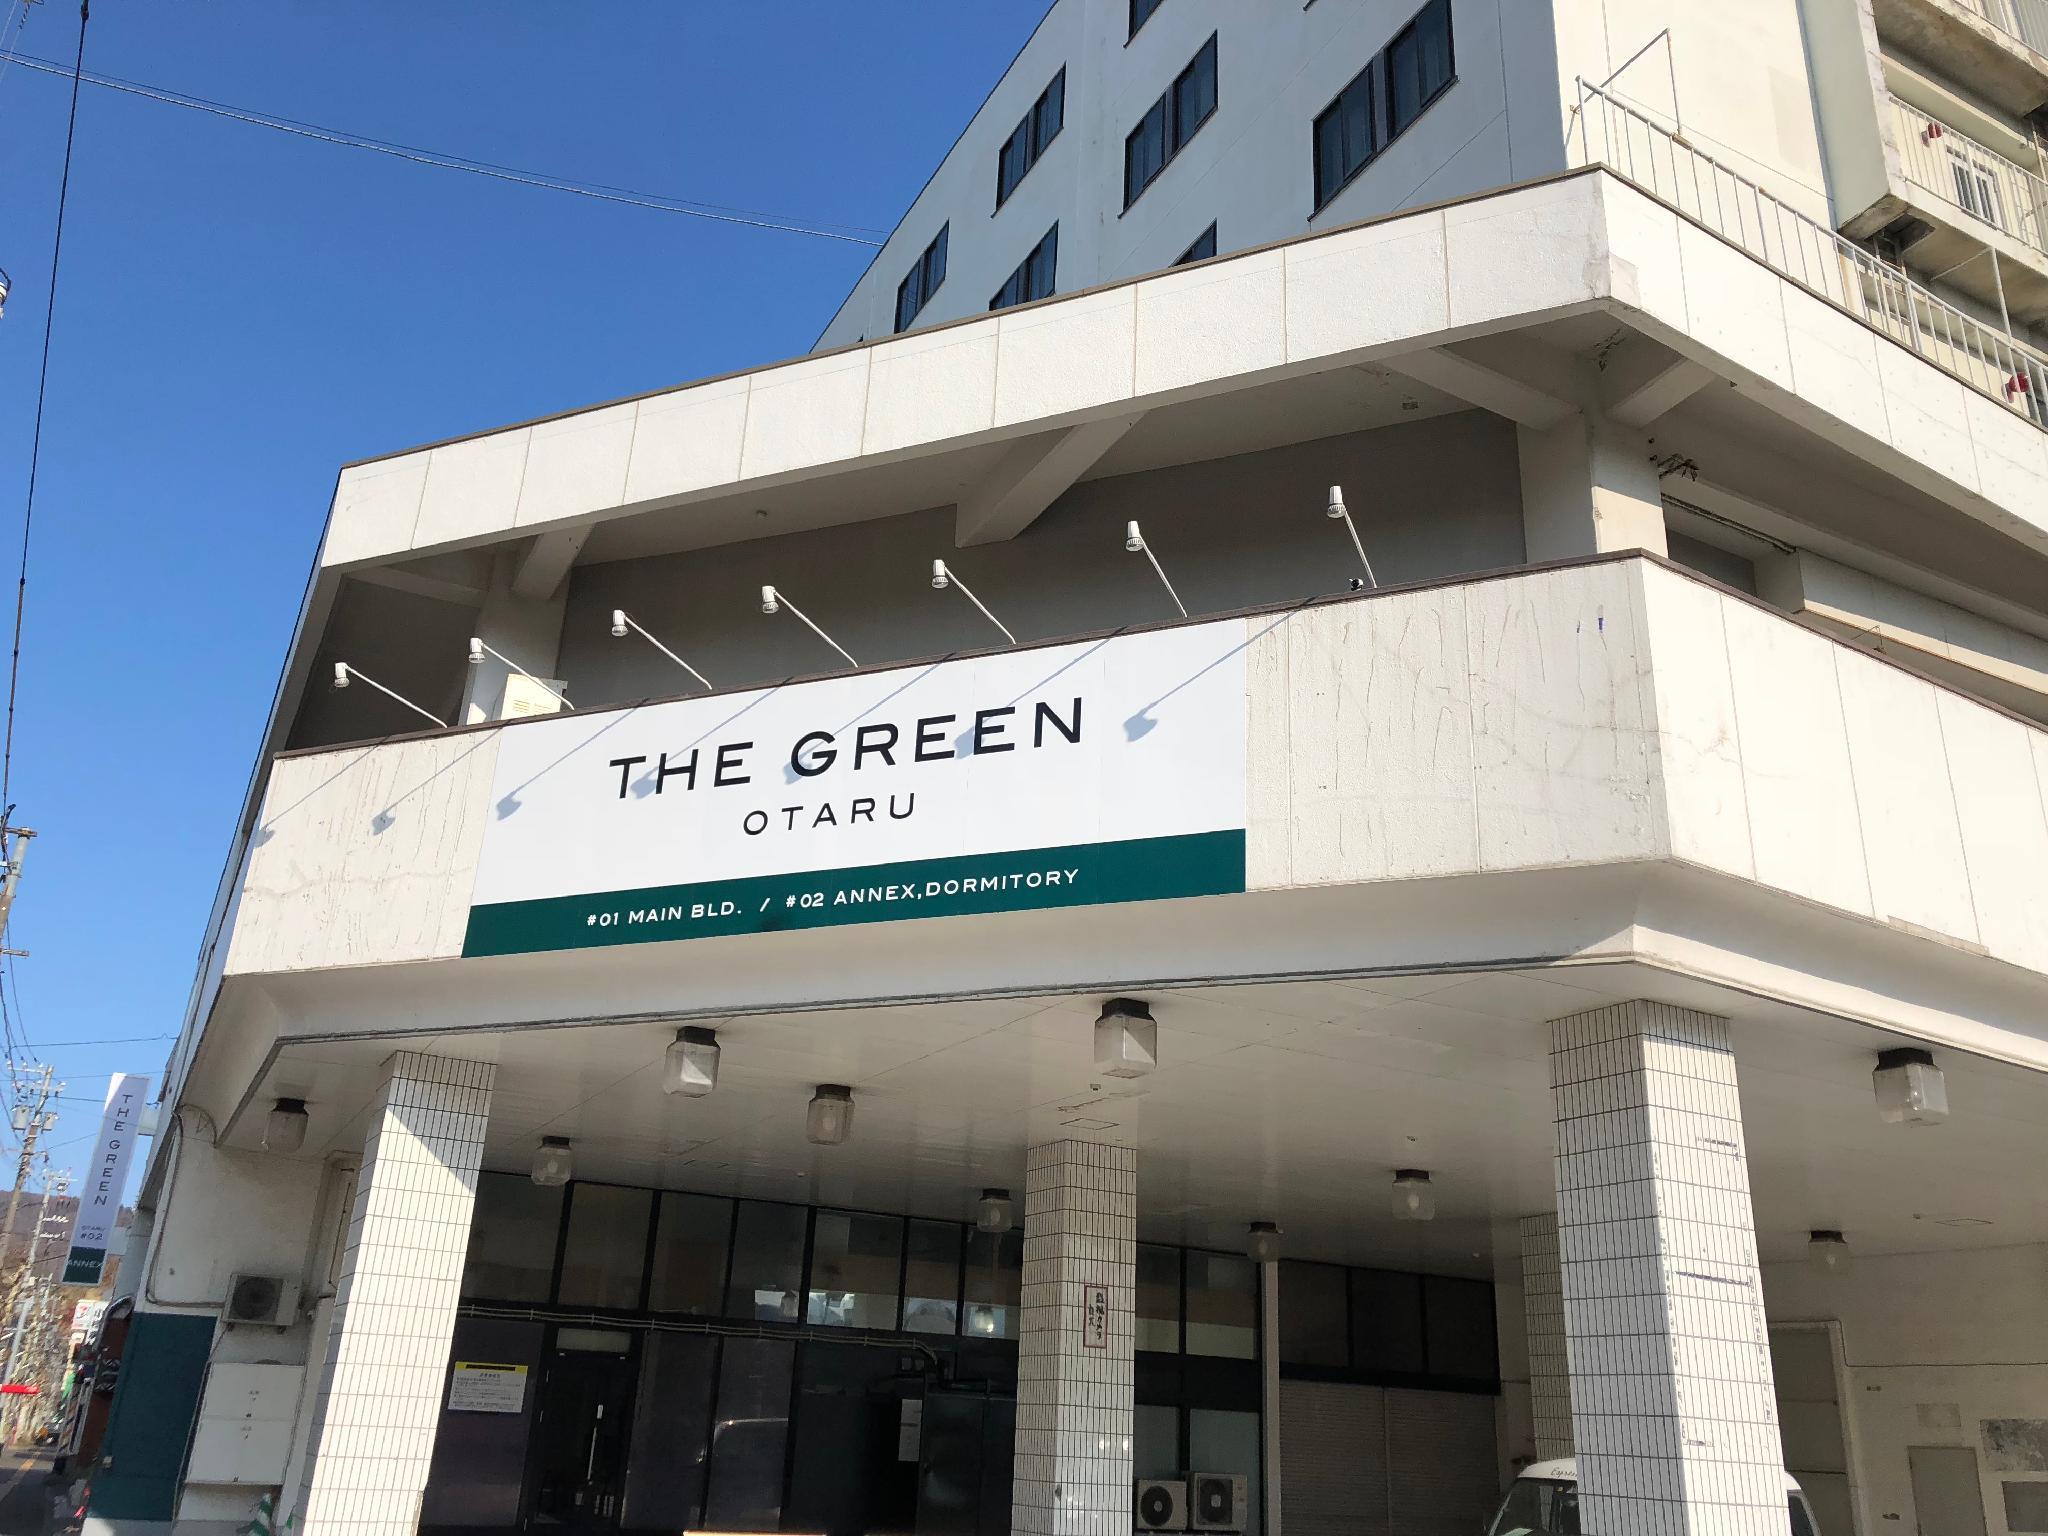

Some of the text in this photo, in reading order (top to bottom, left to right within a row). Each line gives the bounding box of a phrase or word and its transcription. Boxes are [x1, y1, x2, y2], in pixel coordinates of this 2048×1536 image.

[608, 696, 1082, 799] THE GREEN
[742, 792, 915, 836] OTARU
[586, 911, 619, 927] #01
[628, 906, 683, 925] MAIN
[690, 901, 743, 919] BLD.
[785, 892, 825, 909] #02
[93, 1094, 134, 1206] THE GREEN
